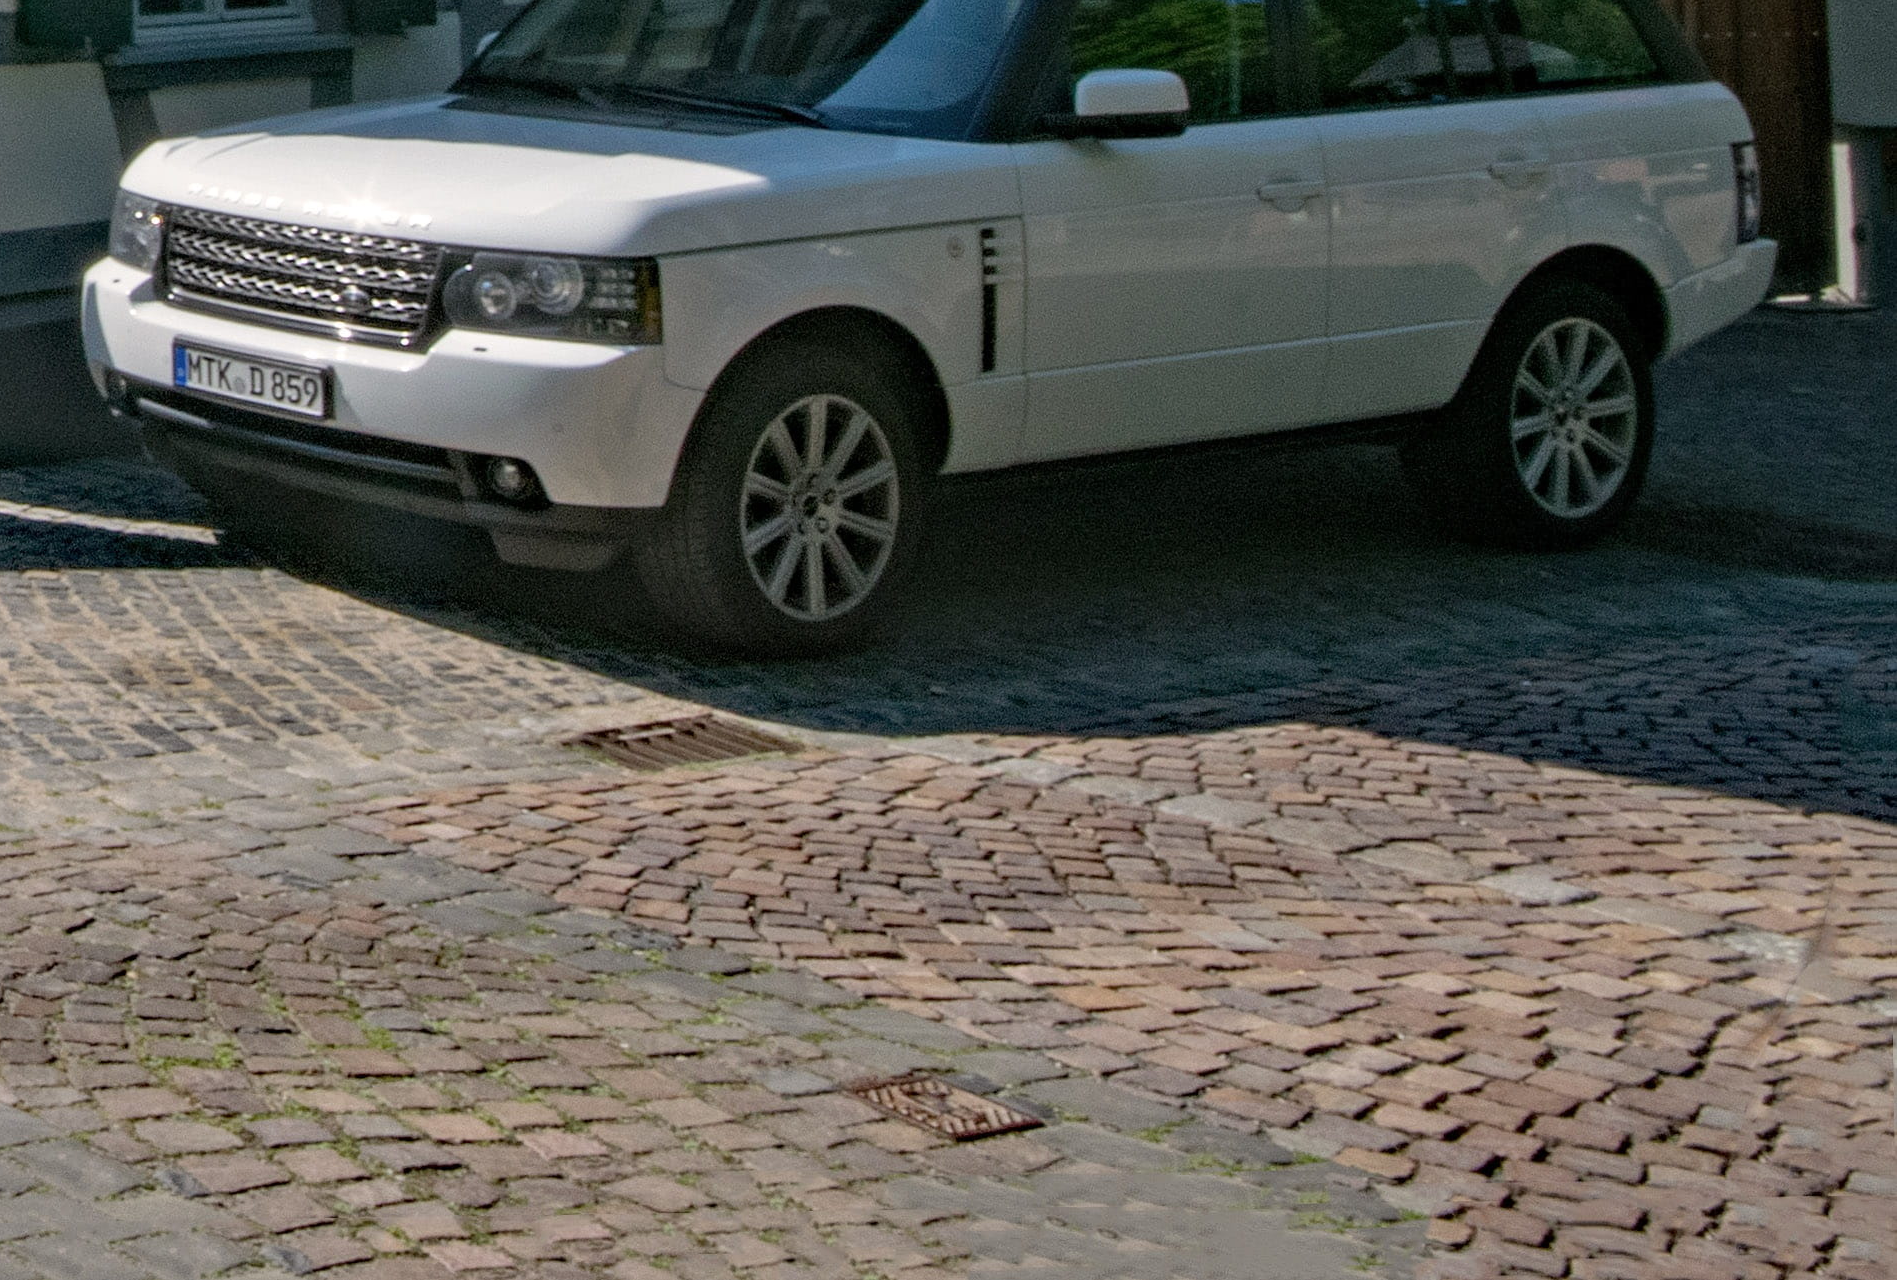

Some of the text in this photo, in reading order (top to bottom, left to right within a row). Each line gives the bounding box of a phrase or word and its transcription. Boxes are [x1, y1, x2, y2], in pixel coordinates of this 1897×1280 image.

[188, 353, 318, 407] MTK D 859
